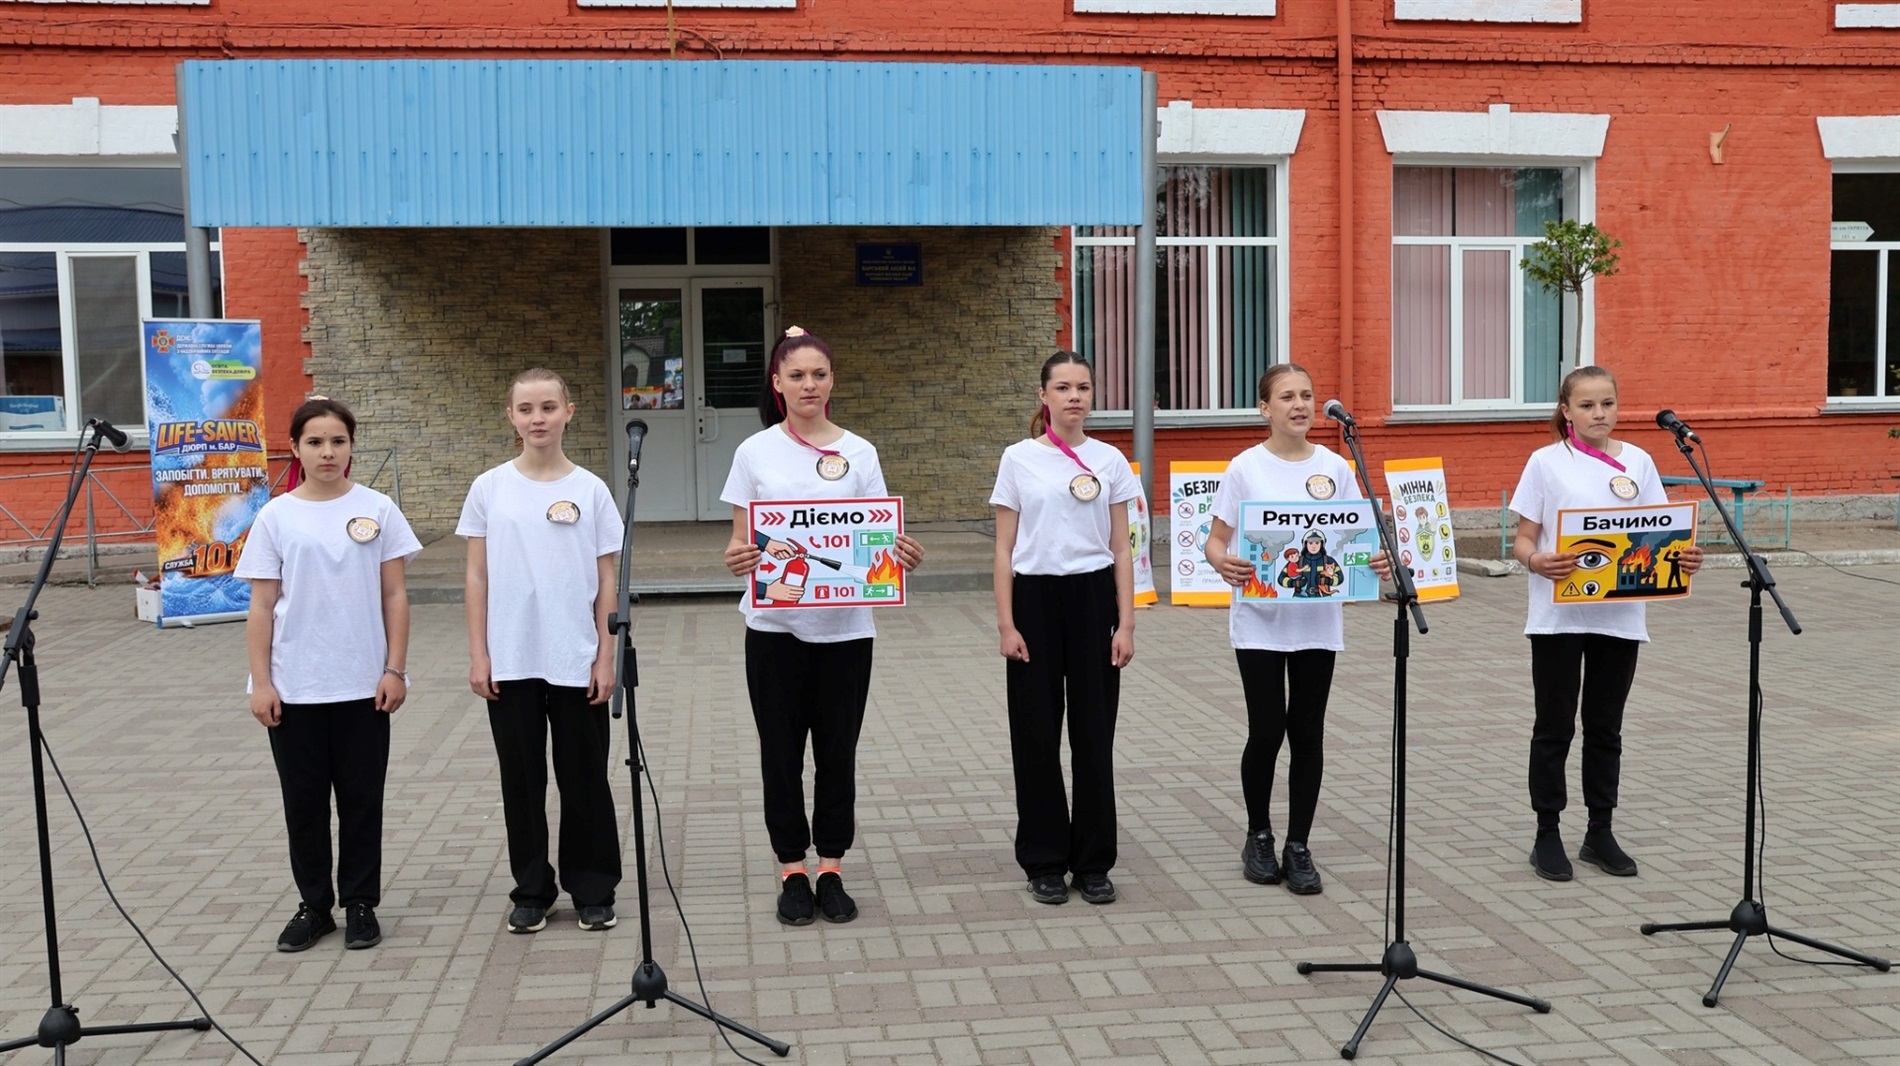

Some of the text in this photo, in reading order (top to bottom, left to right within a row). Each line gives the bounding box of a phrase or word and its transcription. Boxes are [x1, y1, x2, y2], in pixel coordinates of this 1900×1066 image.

[158, 421, 259, 448] LIFE-SAVER
[182, 443, 207, 453] ДЮРП
[218, 443, 236, 451] БАР
[155, 466, 265, 482] ЗАПОБІГТИ. ВРЯТУВАТИ.
[184, 482, 243, 496] ДОПОМОГТИ.
[1399, 480, 1435, 496] МІННА
[1404, 494, 1436, 505] БЕЗПЕКА
[790, 507, 865, 529] Діємо
[1263, 510, 1359, 529] Рятуємо
[1583, 514, 1673, 531] Бачимо
[822, 534, 850, 548] 101
[164, 541, 241, 574] СЛУЖБА 101
[833, 586, 855, 598] 101
